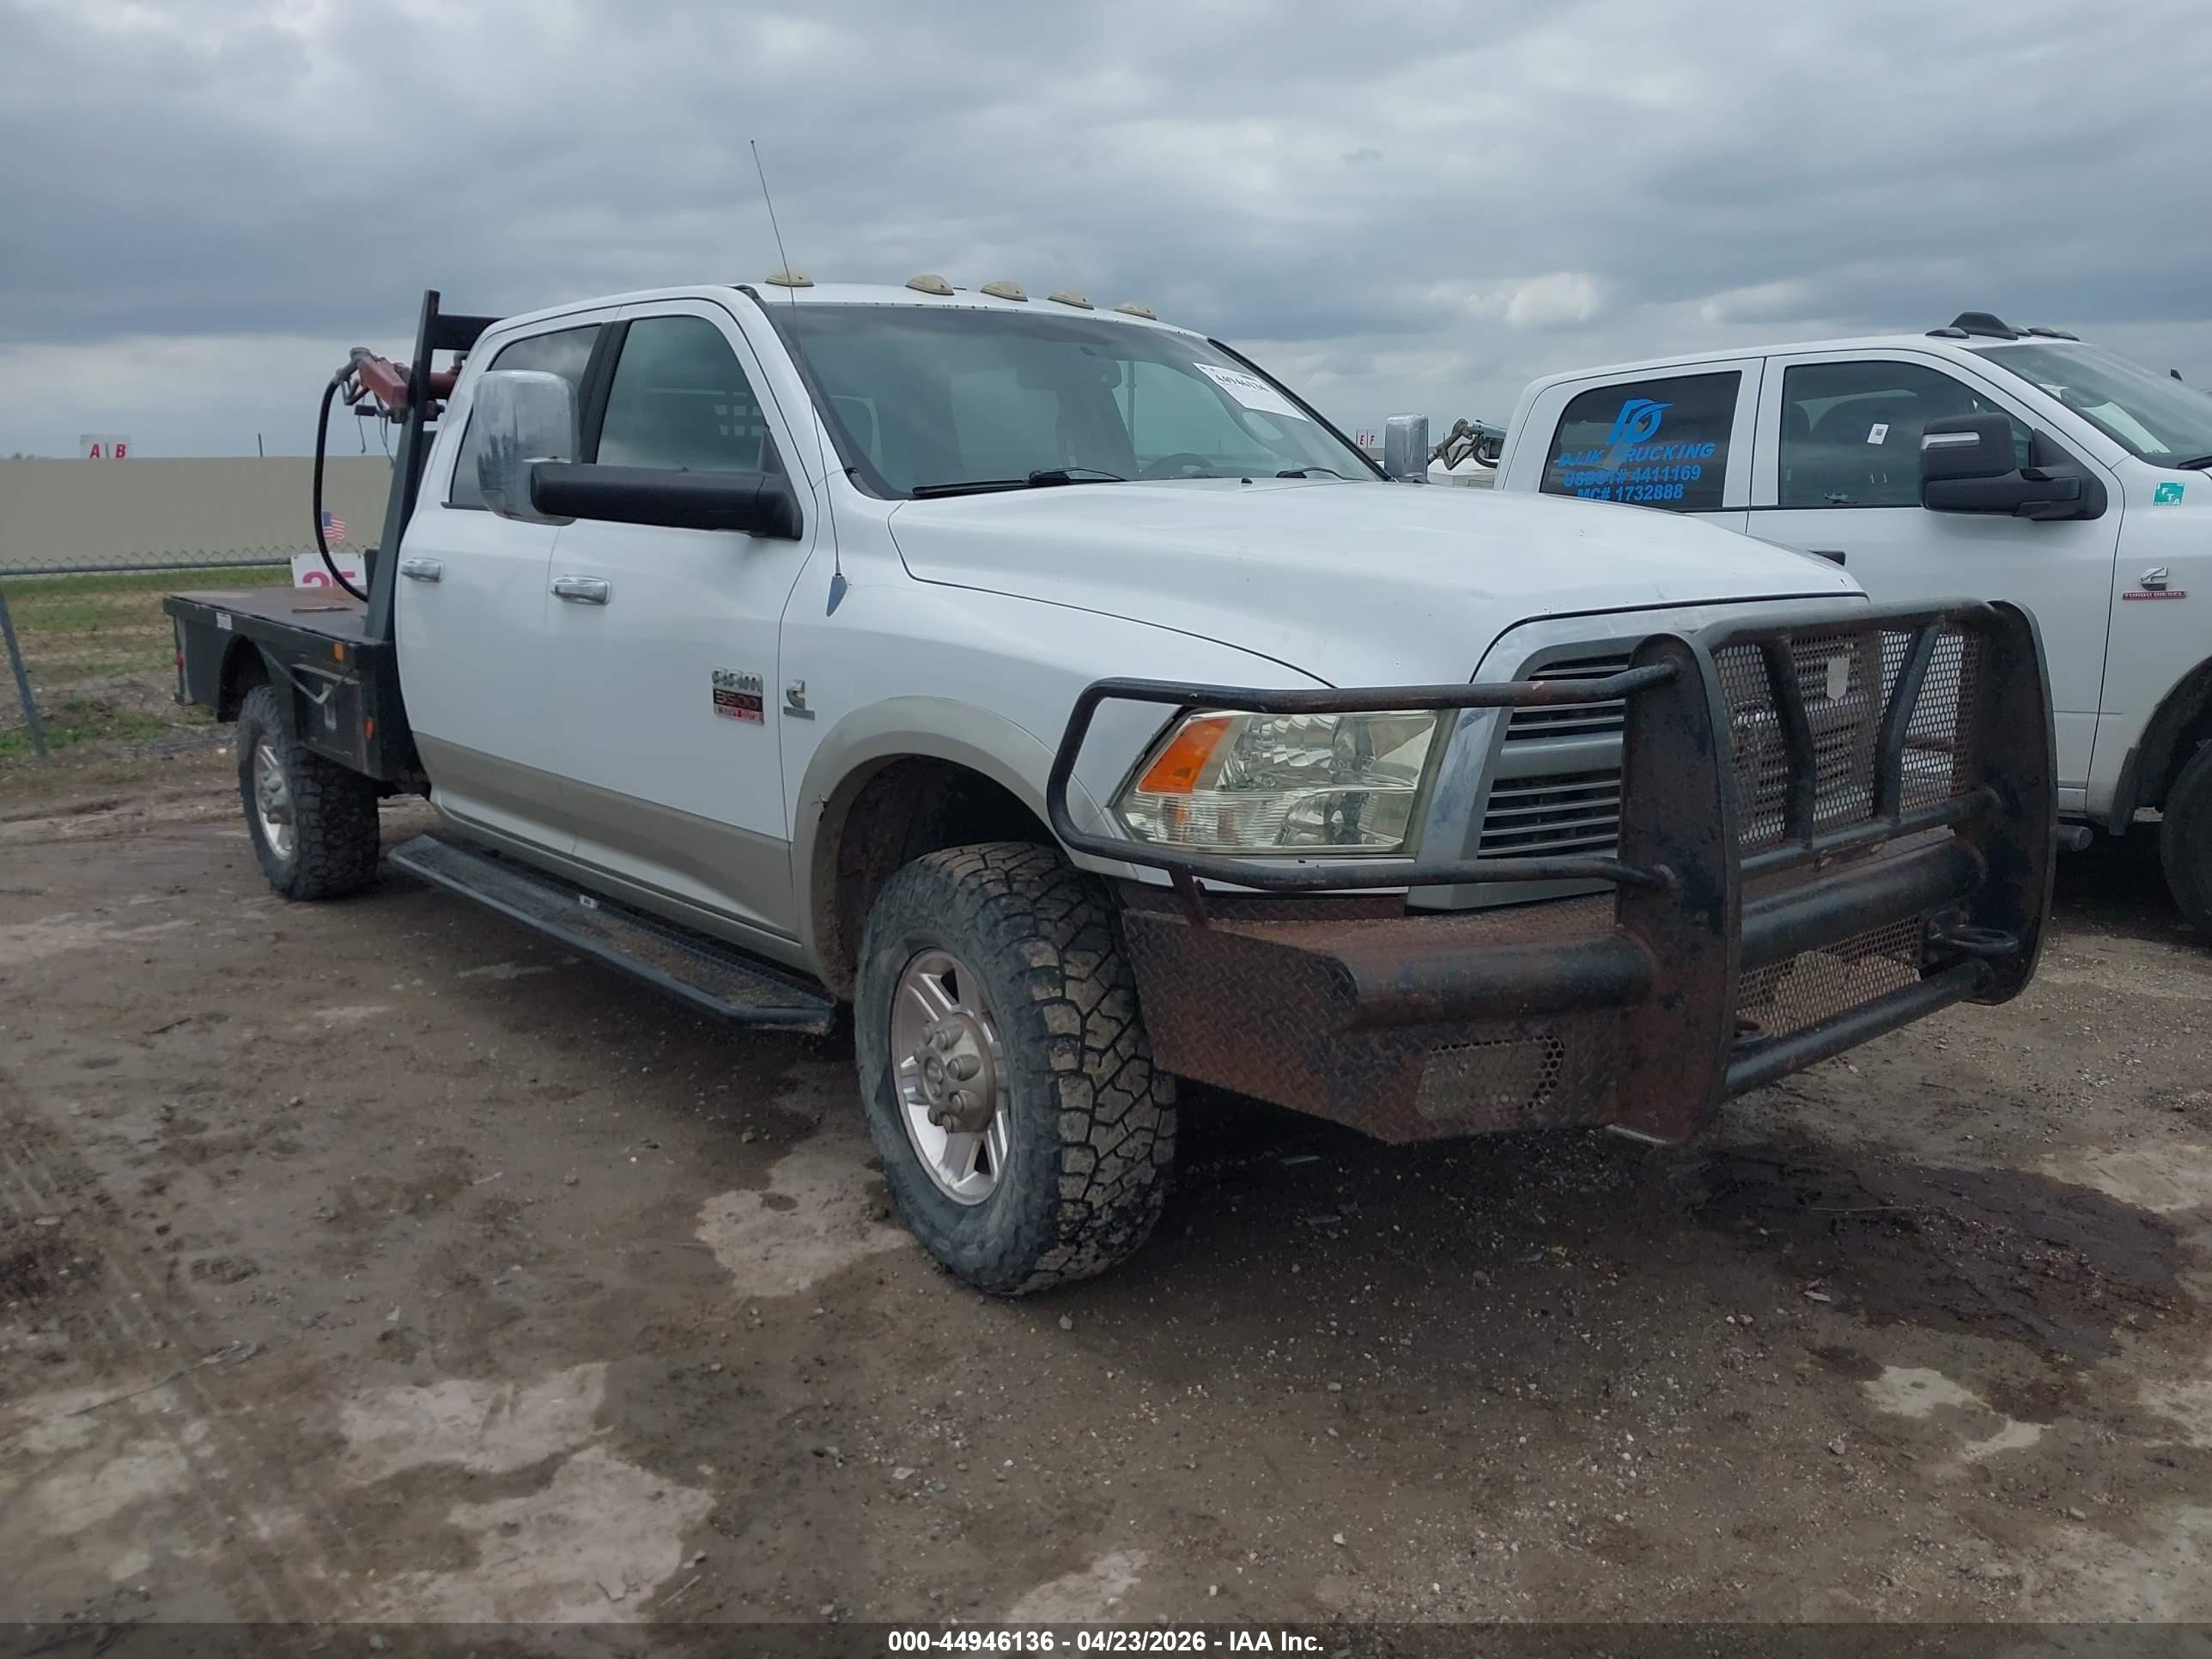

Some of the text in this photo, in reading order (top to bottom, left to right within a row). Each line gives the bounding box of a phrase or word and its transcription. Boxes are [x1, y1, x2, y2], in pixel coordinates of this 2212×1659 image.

[1359, 434, 1365, 446] E
[1370, 434, 1375, 446] F
[89, 443, 100, 459] A
[115, 443, 126, 459] B
[1632, 465, 1701, 483] 4411169
[1615, 483, 1684, 501] 1732888
